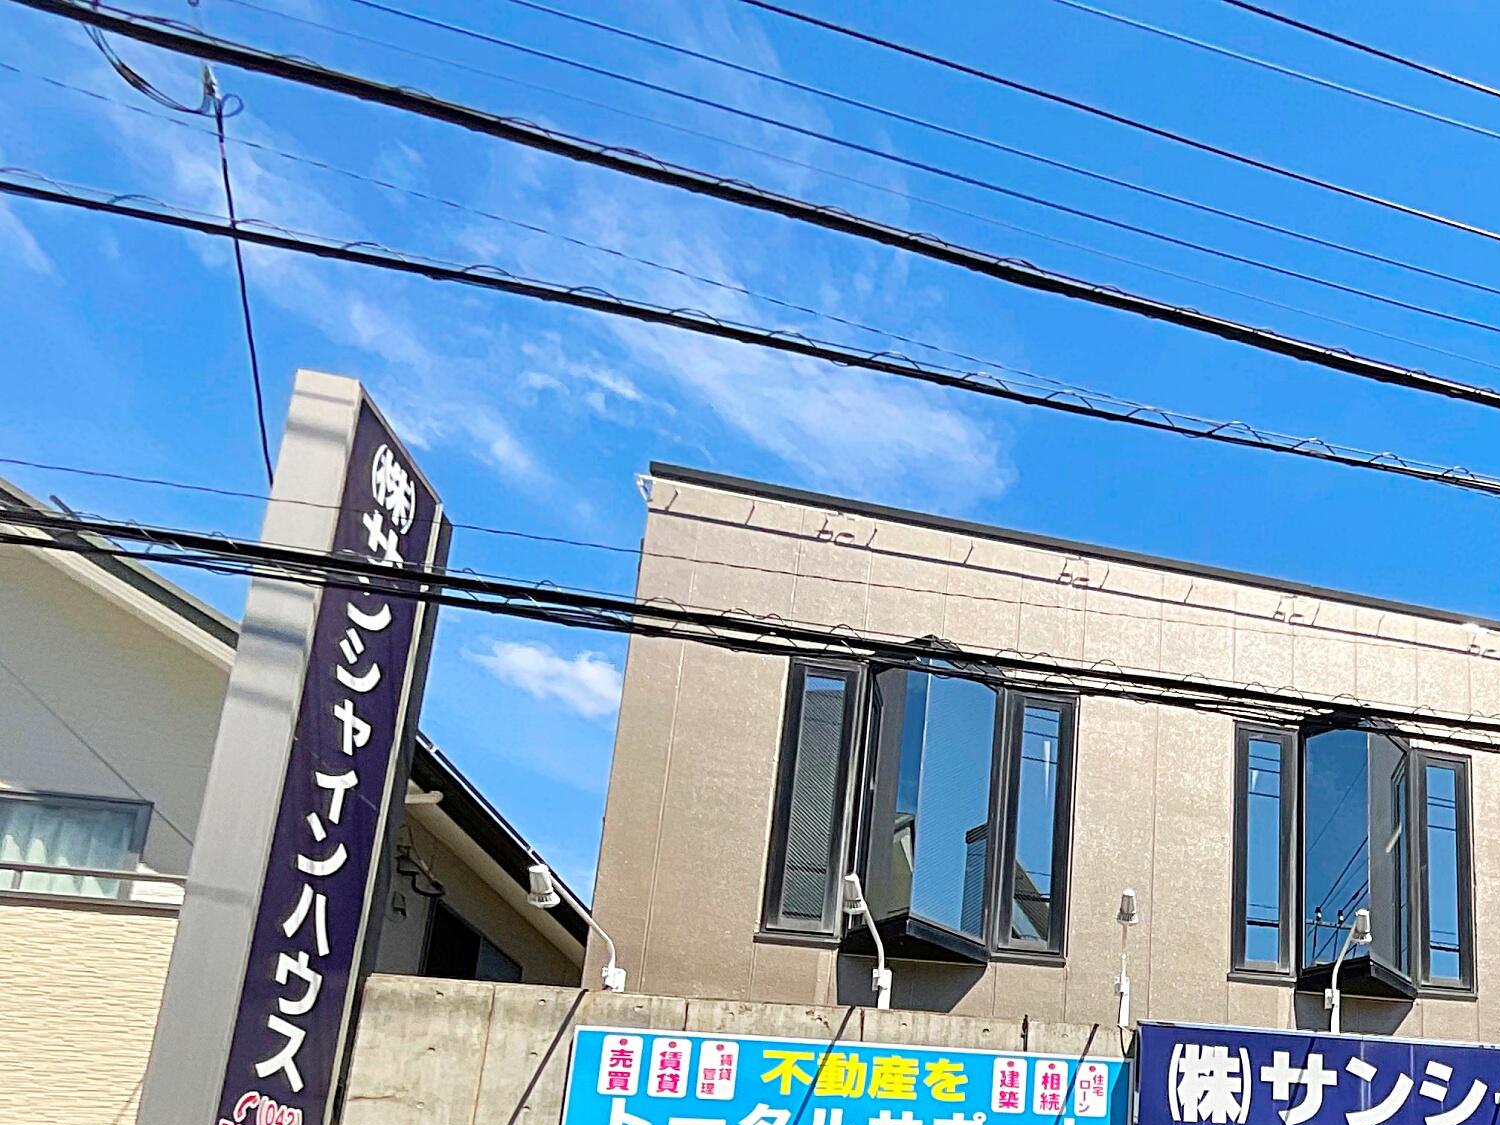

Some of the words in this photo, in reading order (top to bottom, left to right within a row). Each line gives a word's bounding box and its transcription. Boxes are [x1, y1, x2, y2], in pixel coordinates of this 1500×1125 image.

[606, 1048, 634, 1091] 売買
[656, 1051, 683, 1094] 賃貸
[760, 1049, 969, 1102] 不動産を
[998, 1070, 1020, 1109] 建築
[1039, 1073, 1061, 1111] 相続
